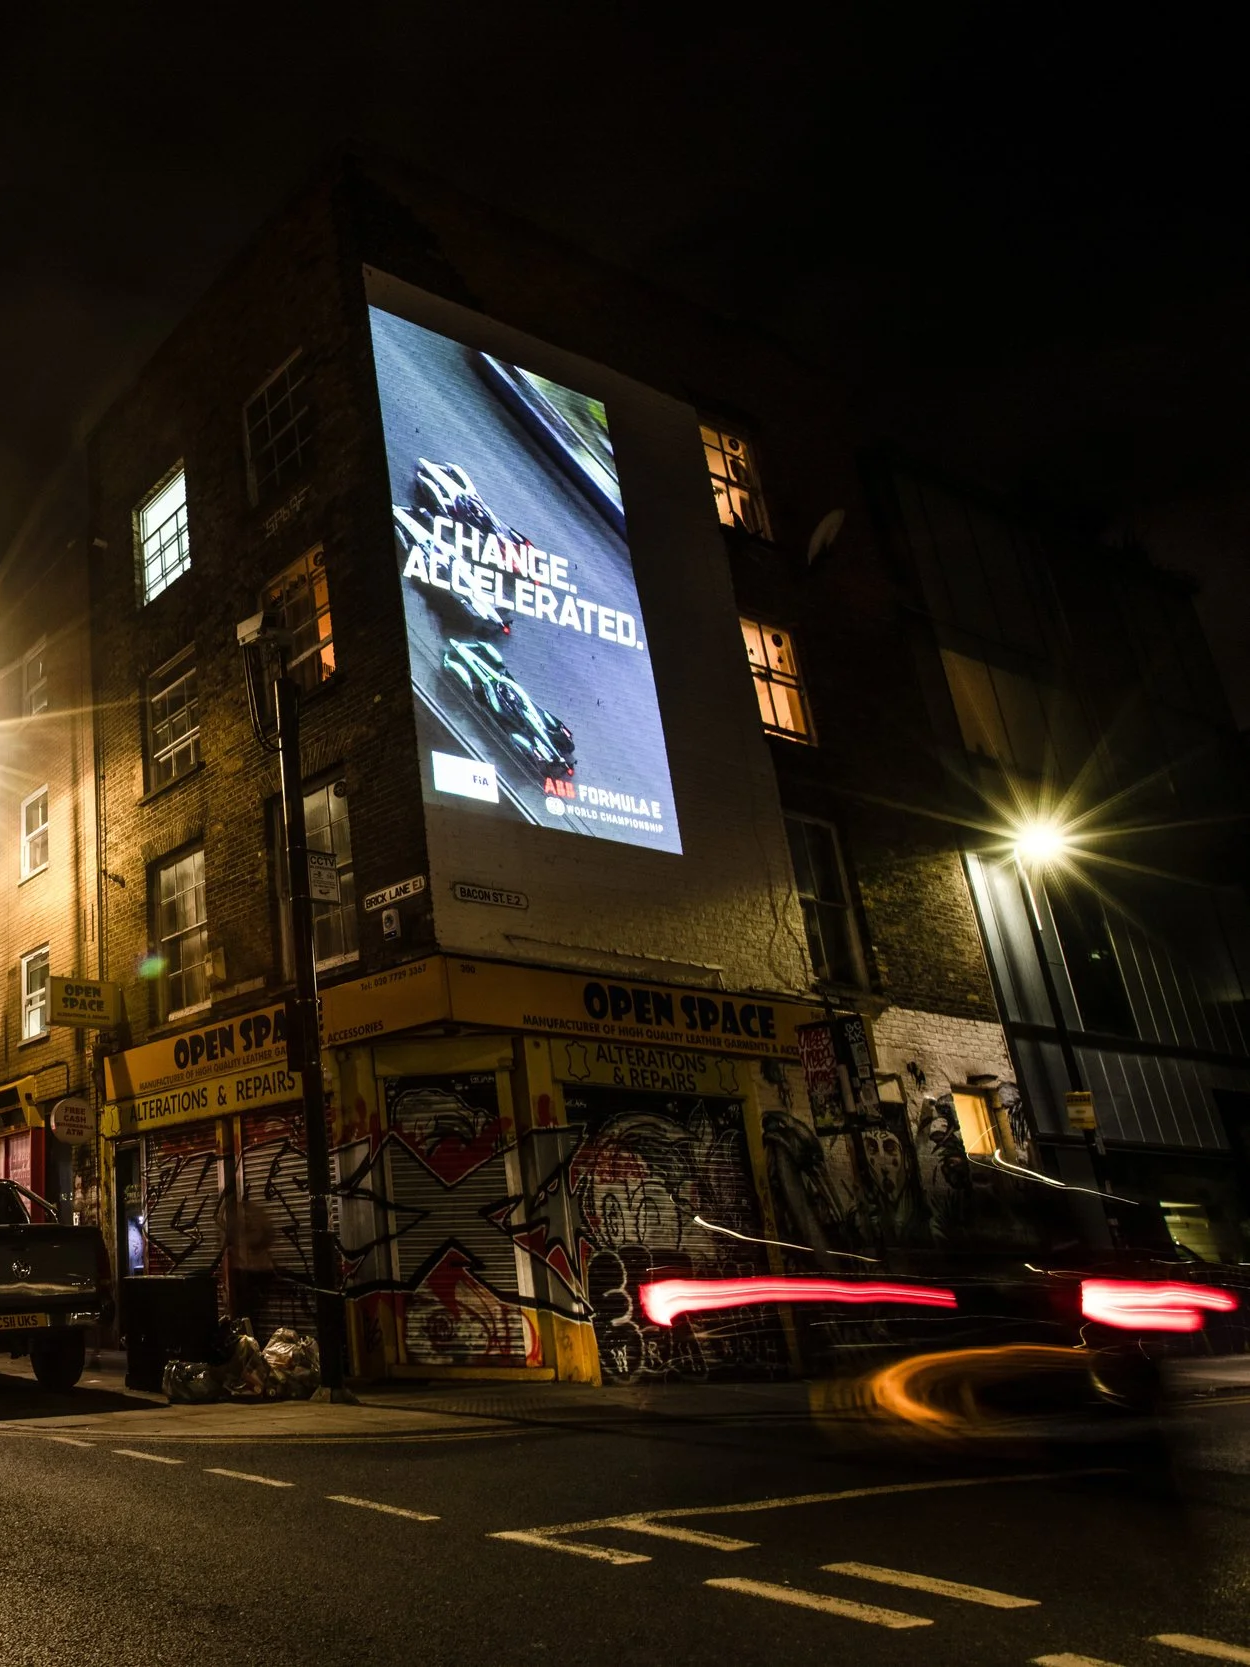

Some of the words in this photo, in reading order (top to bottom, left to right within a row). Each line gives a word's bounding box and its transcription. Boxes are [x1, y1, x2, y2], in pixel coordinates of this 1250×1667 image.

[433, 515, 577, 594] CHANGE.
[402, 545, 644, 650] ACCELERATED.
[543, 776, 577, 800] ABB
[578, 783, 651, 817] FORMULA
[650, 800, 662, 819] E
[565, 804, 598, 820] WORLD
[600, 811, 664, 833] CHAMPIONSHIP
[310, 855, 335, 867] CCTV
[365, 891, 388, 908] BRICK
[388, 882, 411, 901] LANE
[459, 886, 491, 902] BACON
[492, 891, 506, 904] ST.
[61, 997, 105, 1012] SPACE
[64, 983, 102, 998] OPEN
[583, 982, 675, 1028] OPEN
[680, 995, 776, 1040] SPACE
[327, 1020, 384, 1043] ACCESSORIES
[522, 1014, 601, 1034] MANUFACTURER
[602, 1023, 616, 1036] OF
[618, 1025, 644, 1037] HIGH
[645, 1028, 684, 1043] QUALITY
[685, 1032, 722, 1047] LEATHER
[173, 1023, 235, 1070] OPEN
[596, 1044, 707, 1074] ALTERATIONS
[139, 1070, 184, 1090] MANUFACTURER
[185, 1069, 195, 1080] OF
[195, 1066, 213, 1078] HIGH
[214, 1057, 241, 1073] QUALITY
[242, 1050, 272, 1065] LEATHER
[613, 1066, 625, 1086] &
[629, 1069, 697, 1093] REPAIRS
[129, 1087, 208, 1123] ALTERATIONS
[217, 1085, 228, 1106] &
[236, 1070, 296, 1102] REPAIRS
[17, 1314, 38, 1327] UKS
